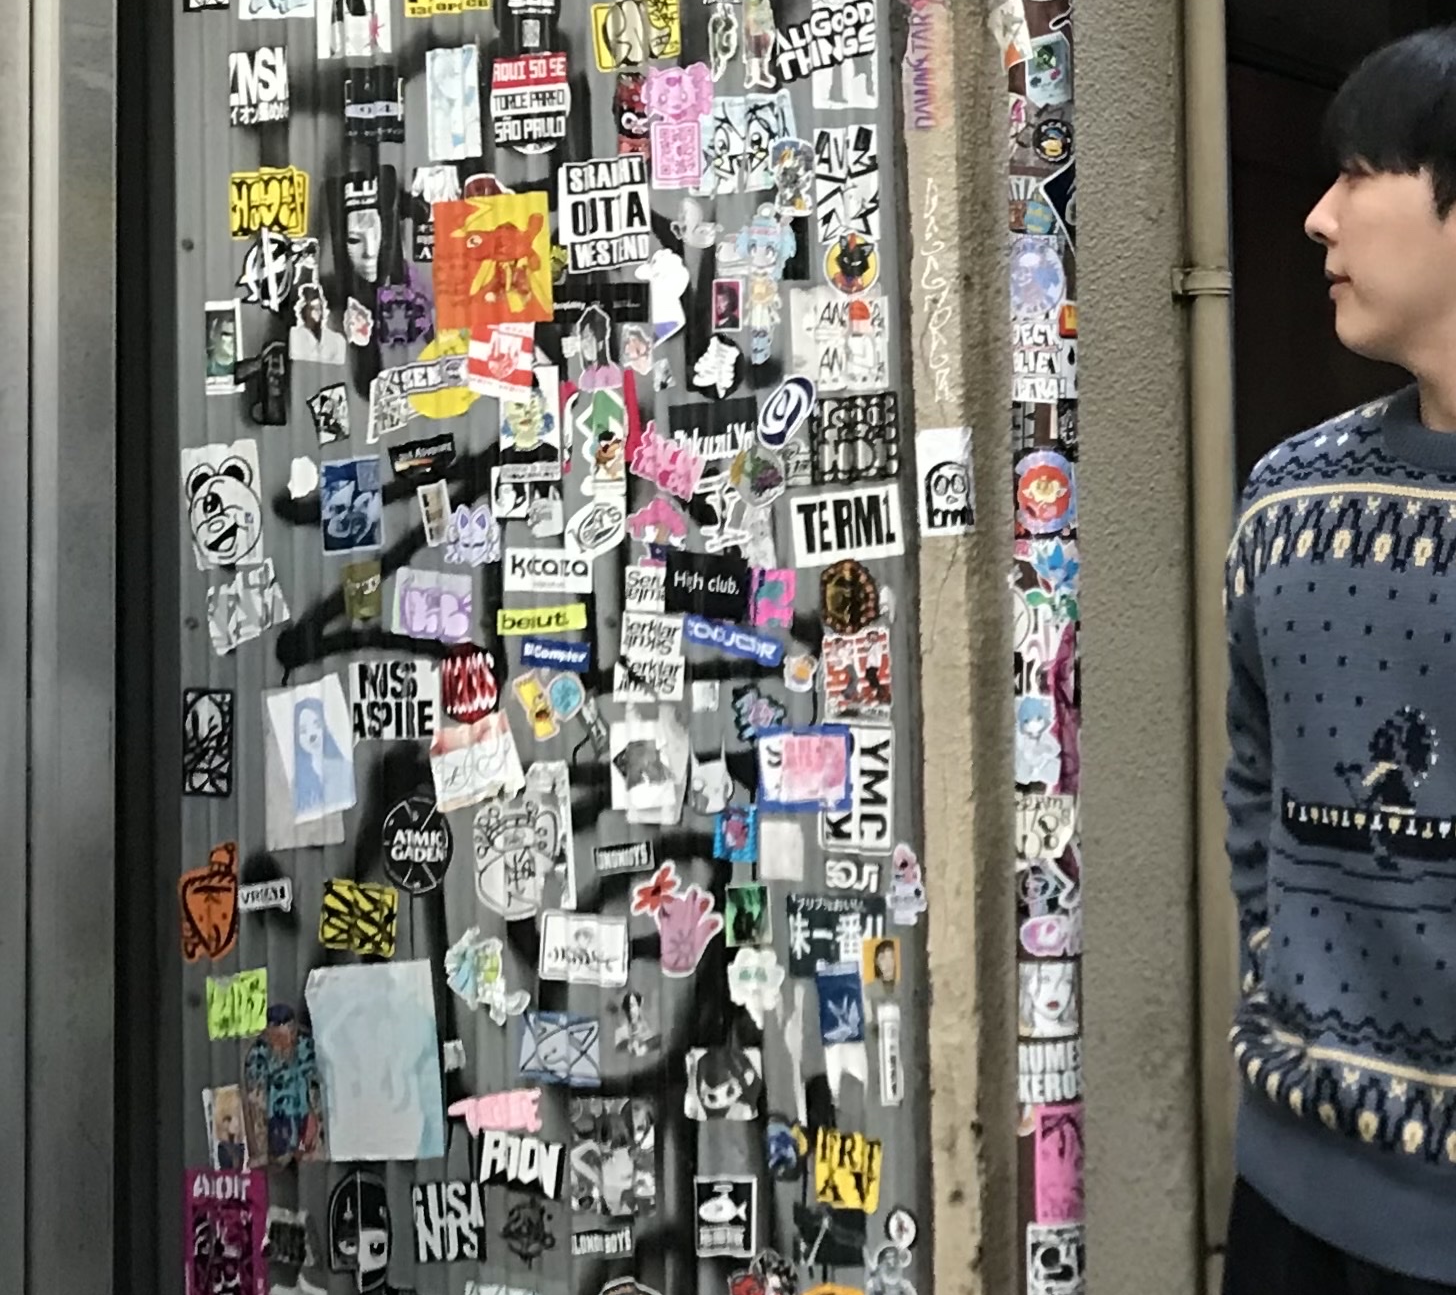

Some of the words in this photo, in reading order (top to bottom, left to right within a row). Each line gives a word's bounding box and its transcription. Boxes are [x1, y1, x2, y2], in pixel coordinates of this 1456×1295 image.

[810, 2, 874, 37] GOOD
[779, 25, 876, 79] THINGS
[860, 739, 890, 841] YMC
